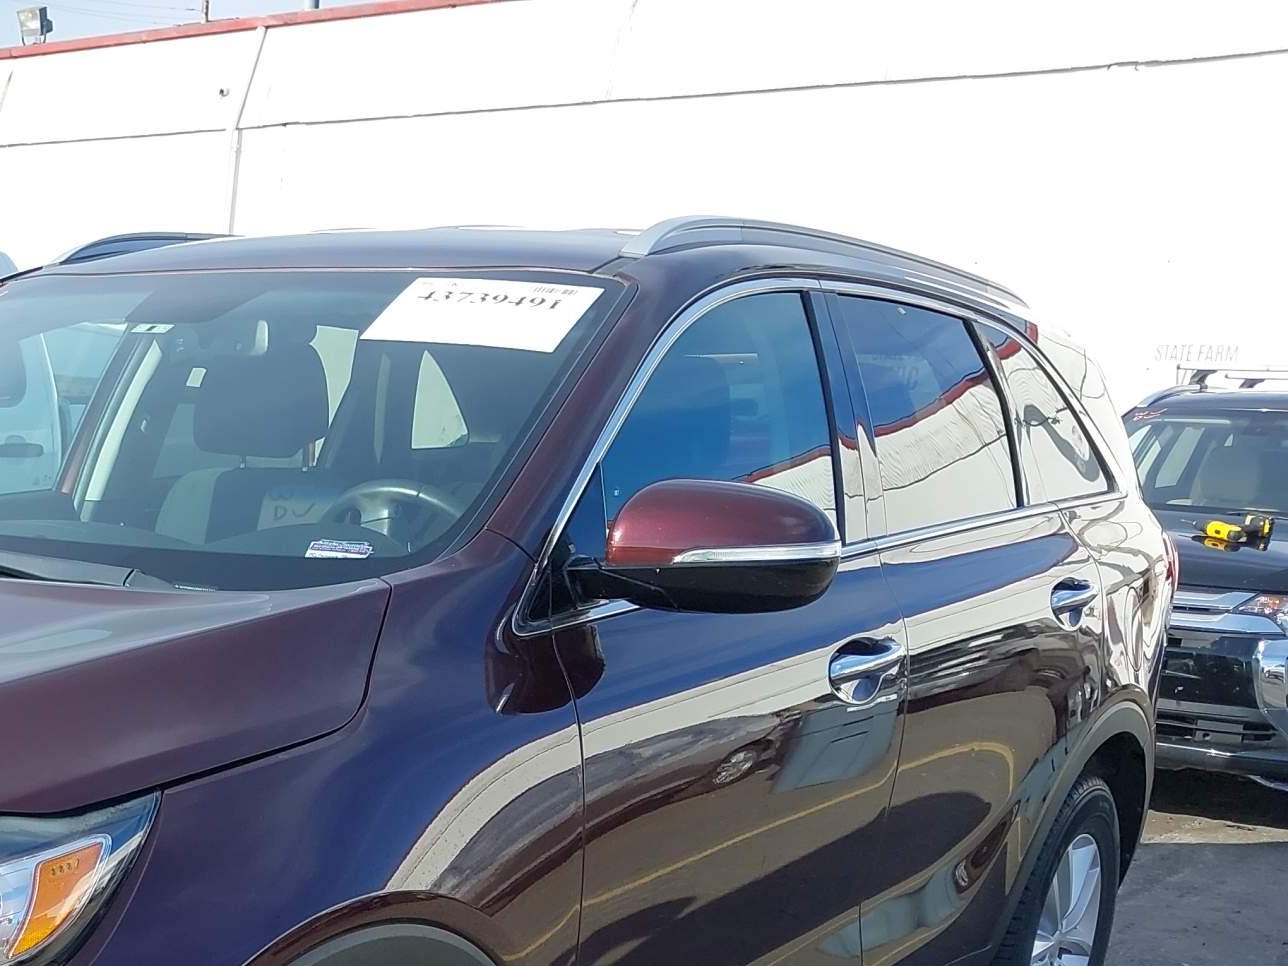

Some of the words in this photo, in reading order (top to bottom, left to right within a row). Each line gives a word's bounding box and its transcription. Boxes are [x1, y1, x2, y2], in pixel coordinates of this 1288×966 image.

[417, 290, 563, 310] 43739491
[1154, 344, 1194, 361] STATE
[1197, 344, 1240, 361] FARM
